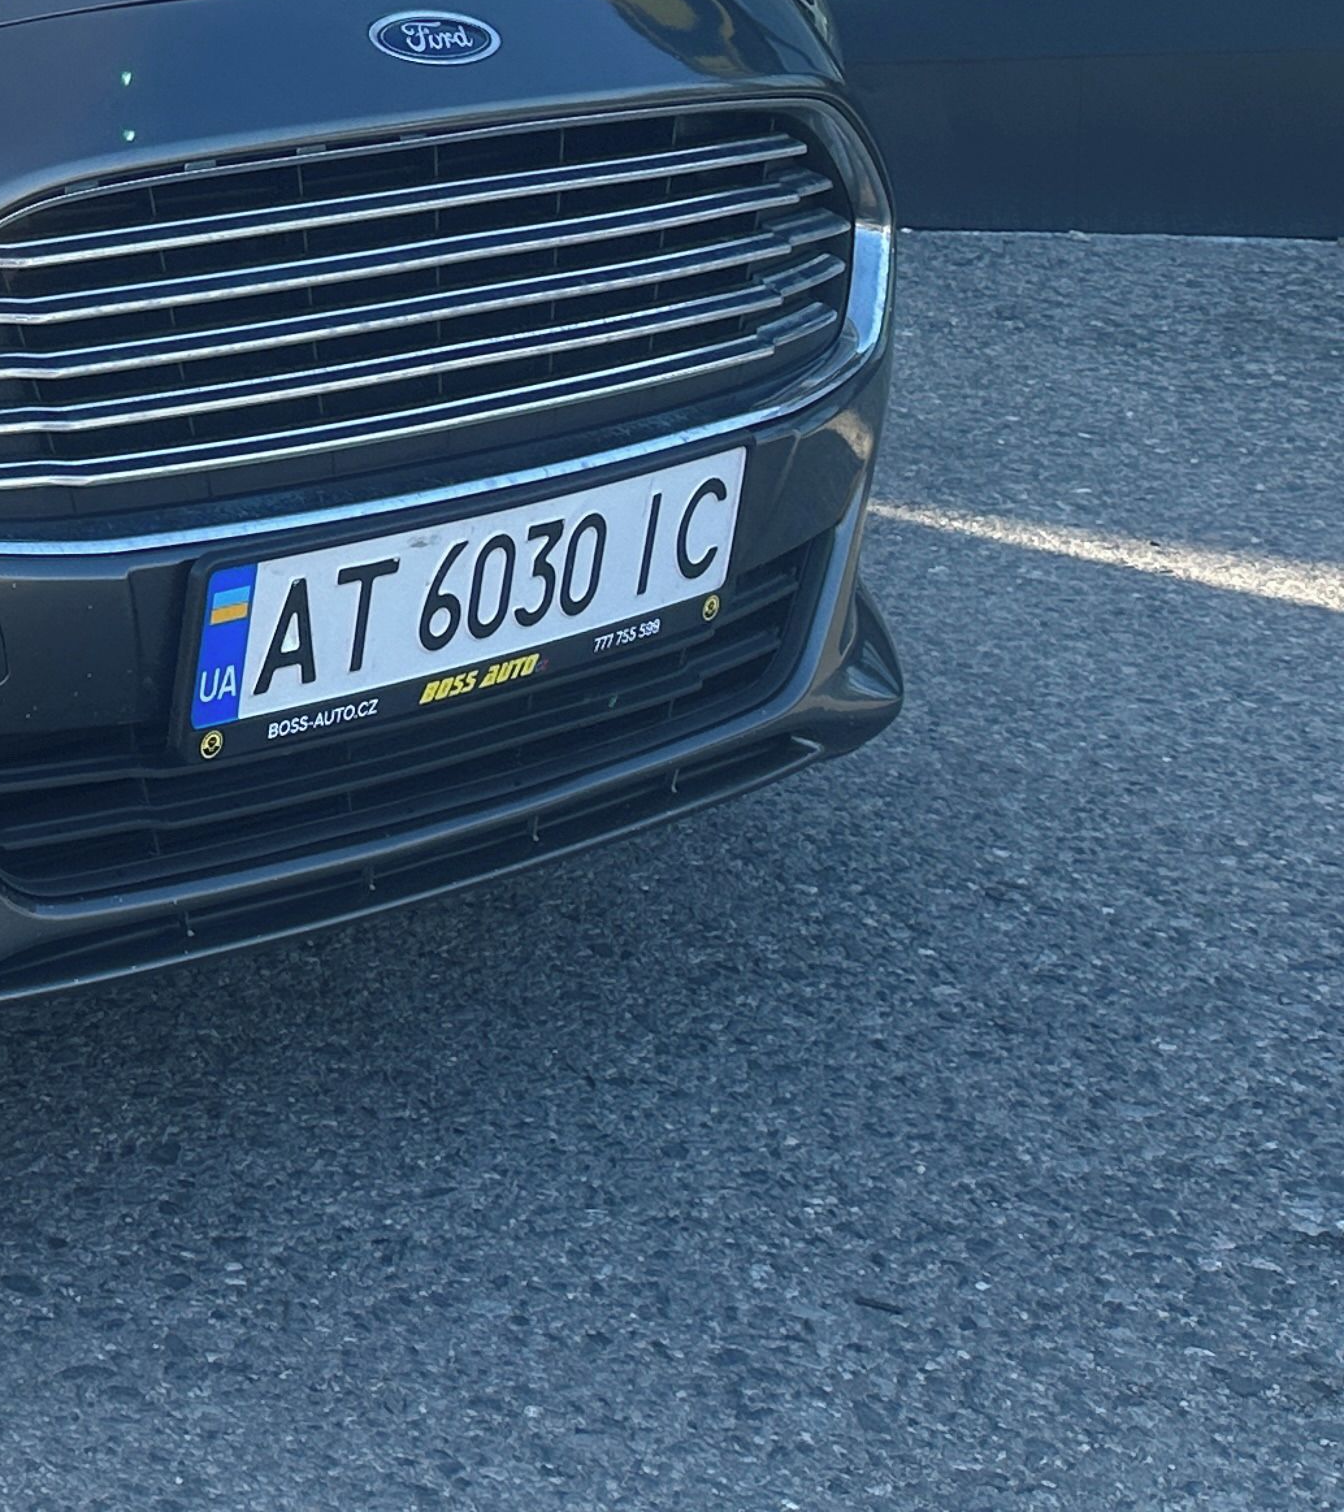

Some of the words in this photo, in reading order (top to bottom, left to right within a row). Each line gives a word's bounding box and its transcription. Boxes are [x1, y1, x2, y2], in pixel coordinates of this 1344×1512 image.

[401, 21, 473, 52] Ford
[252, 557, 400, 696] AT
[418, 512, 608, 652] 6030
[635, 477, 727, 595] IC
[593, 633, 614, 653] 777
[616, 626, 637, 646] 755
[199, 664, 237, 703] UA
[419, 670, 479, 704] BOSS
[478, 653, 540, 689] AUTO
[268, 699, 379, 739] BOSS-AUTO.CZ
